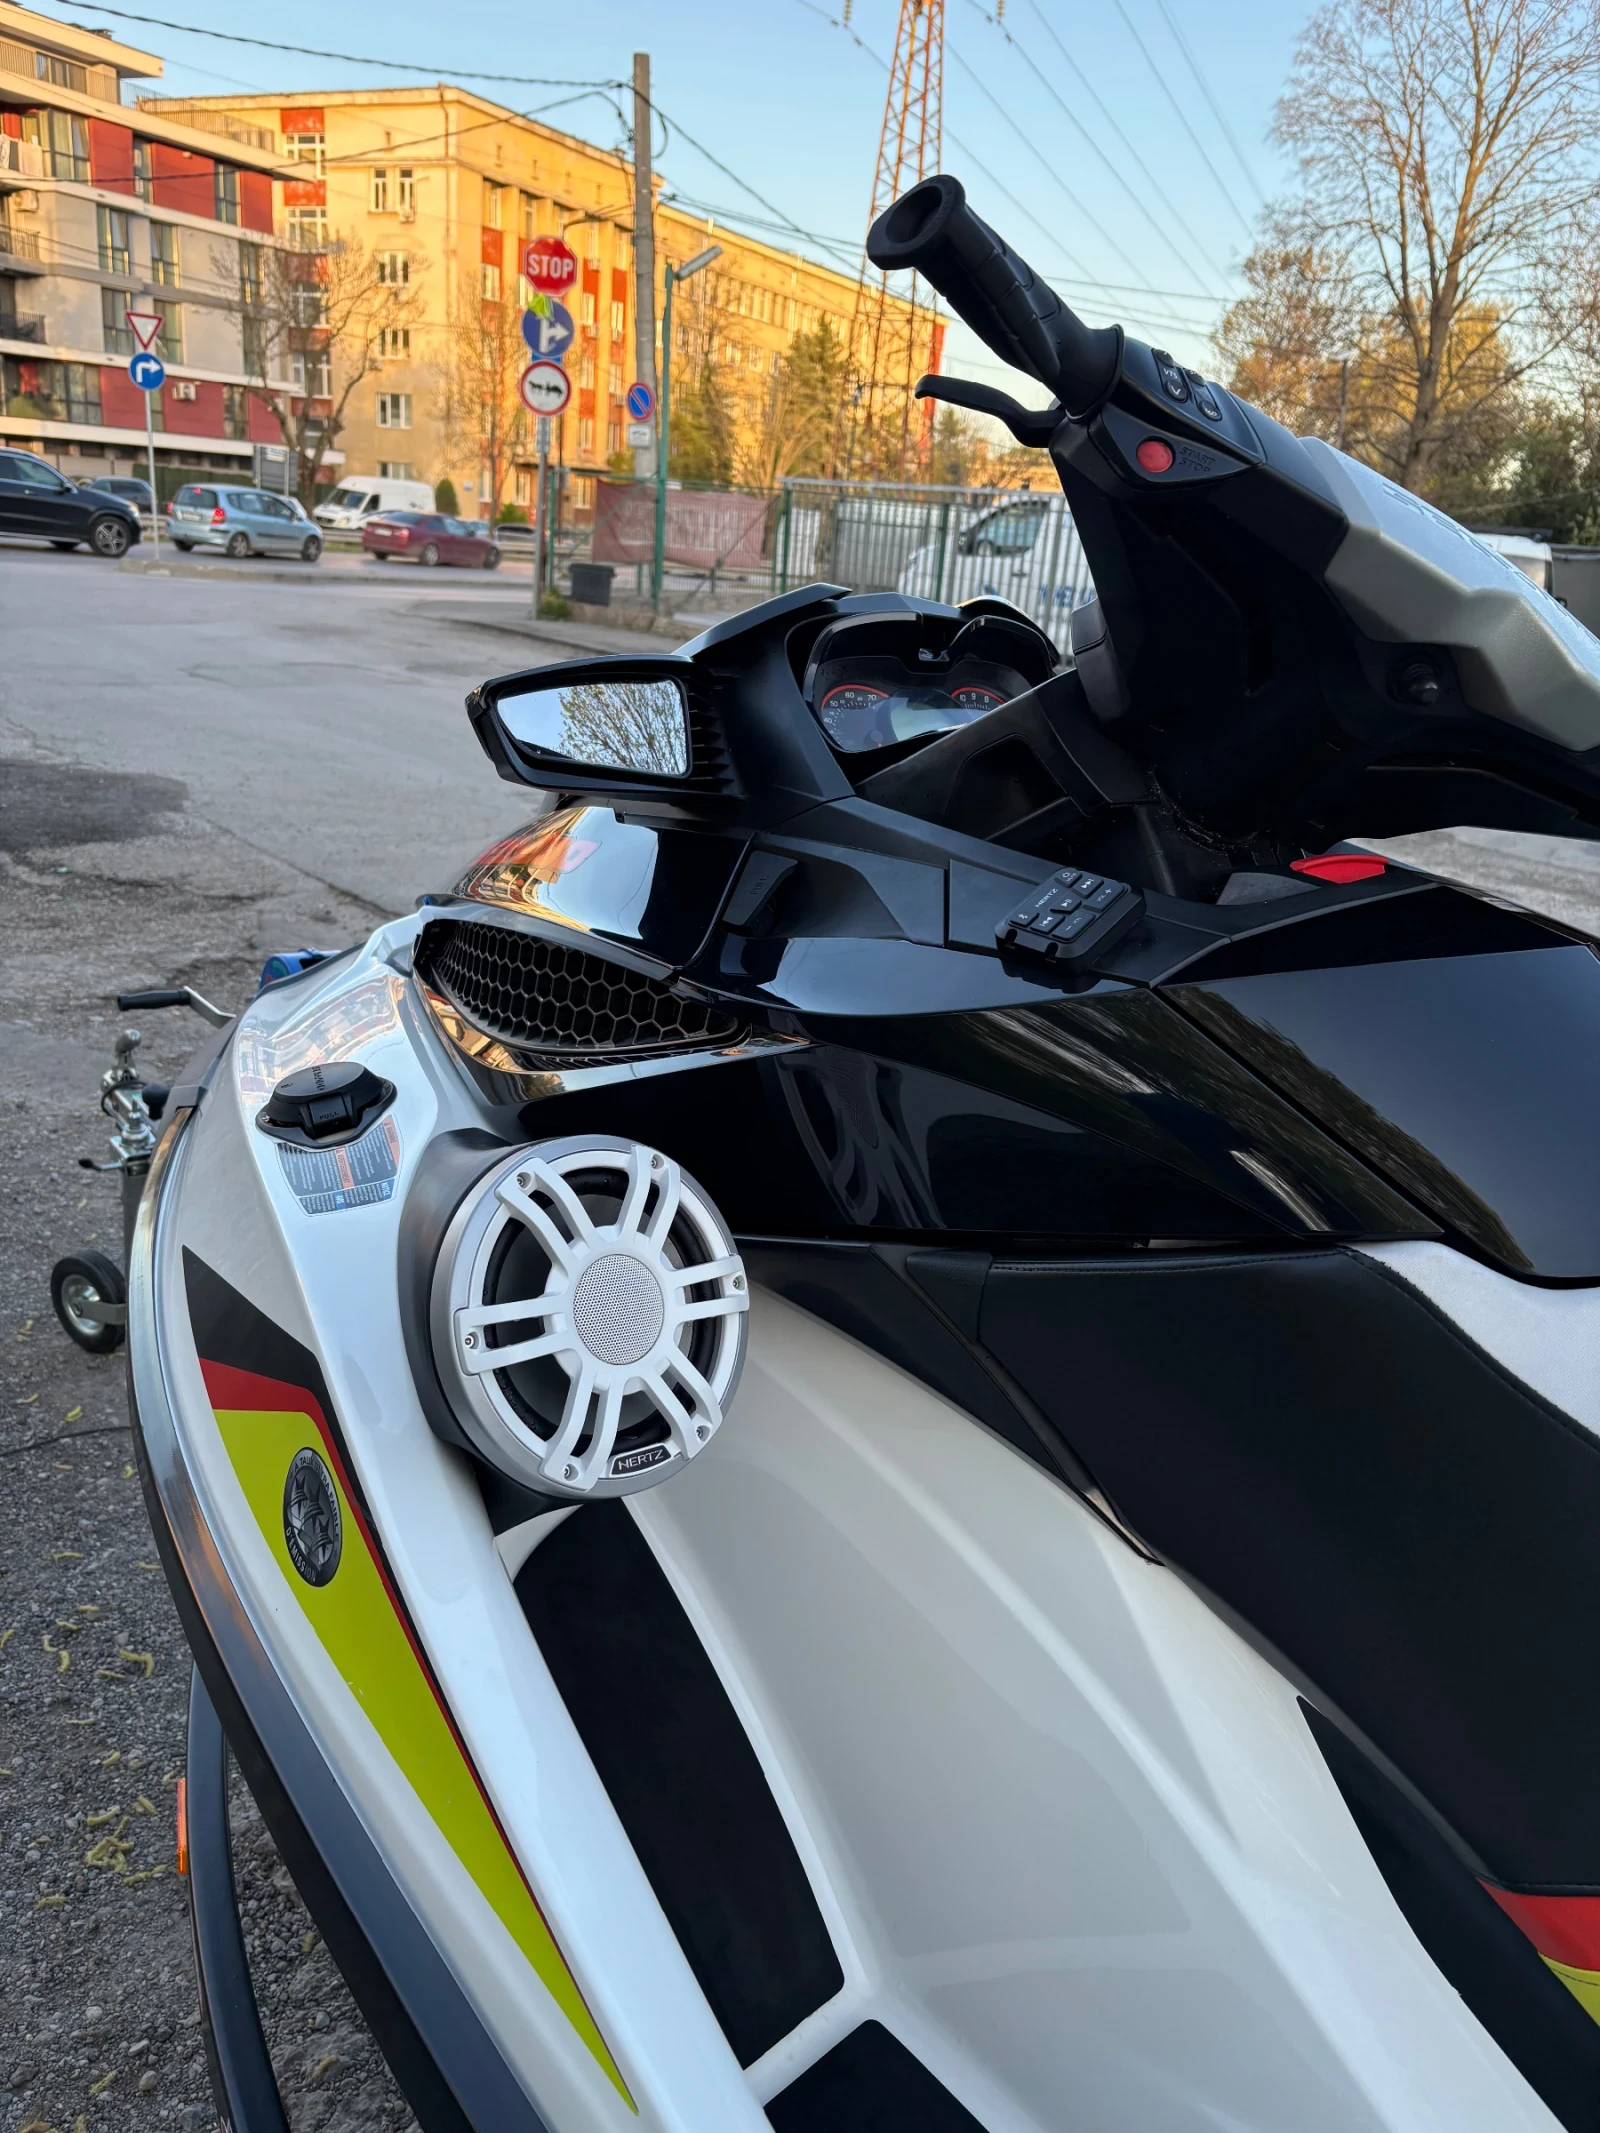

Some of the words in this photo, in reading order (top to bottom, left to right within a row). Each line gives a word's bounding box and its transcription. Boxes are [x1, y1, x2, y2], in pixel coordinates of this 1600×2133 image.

[527, 253, 574, 279] STOP
[1163, 367, 1178, 379] VTS
[1180, 446, 1217, 466] START
[1179, 457, 1211, 473] STOP
[844, 691, 855, 699] 60
[959, 694, 967, 702] 10
[971, 692, 977, 701] 9
[984, 695, 990, 703] 8
[1035, 888, 1058, 908] HERTZ
[319, 1111, 340, 1120] PULL
[299, 1455, 314, 1467] TAUX
[618, 1448, 665, 1471] HERTZ
